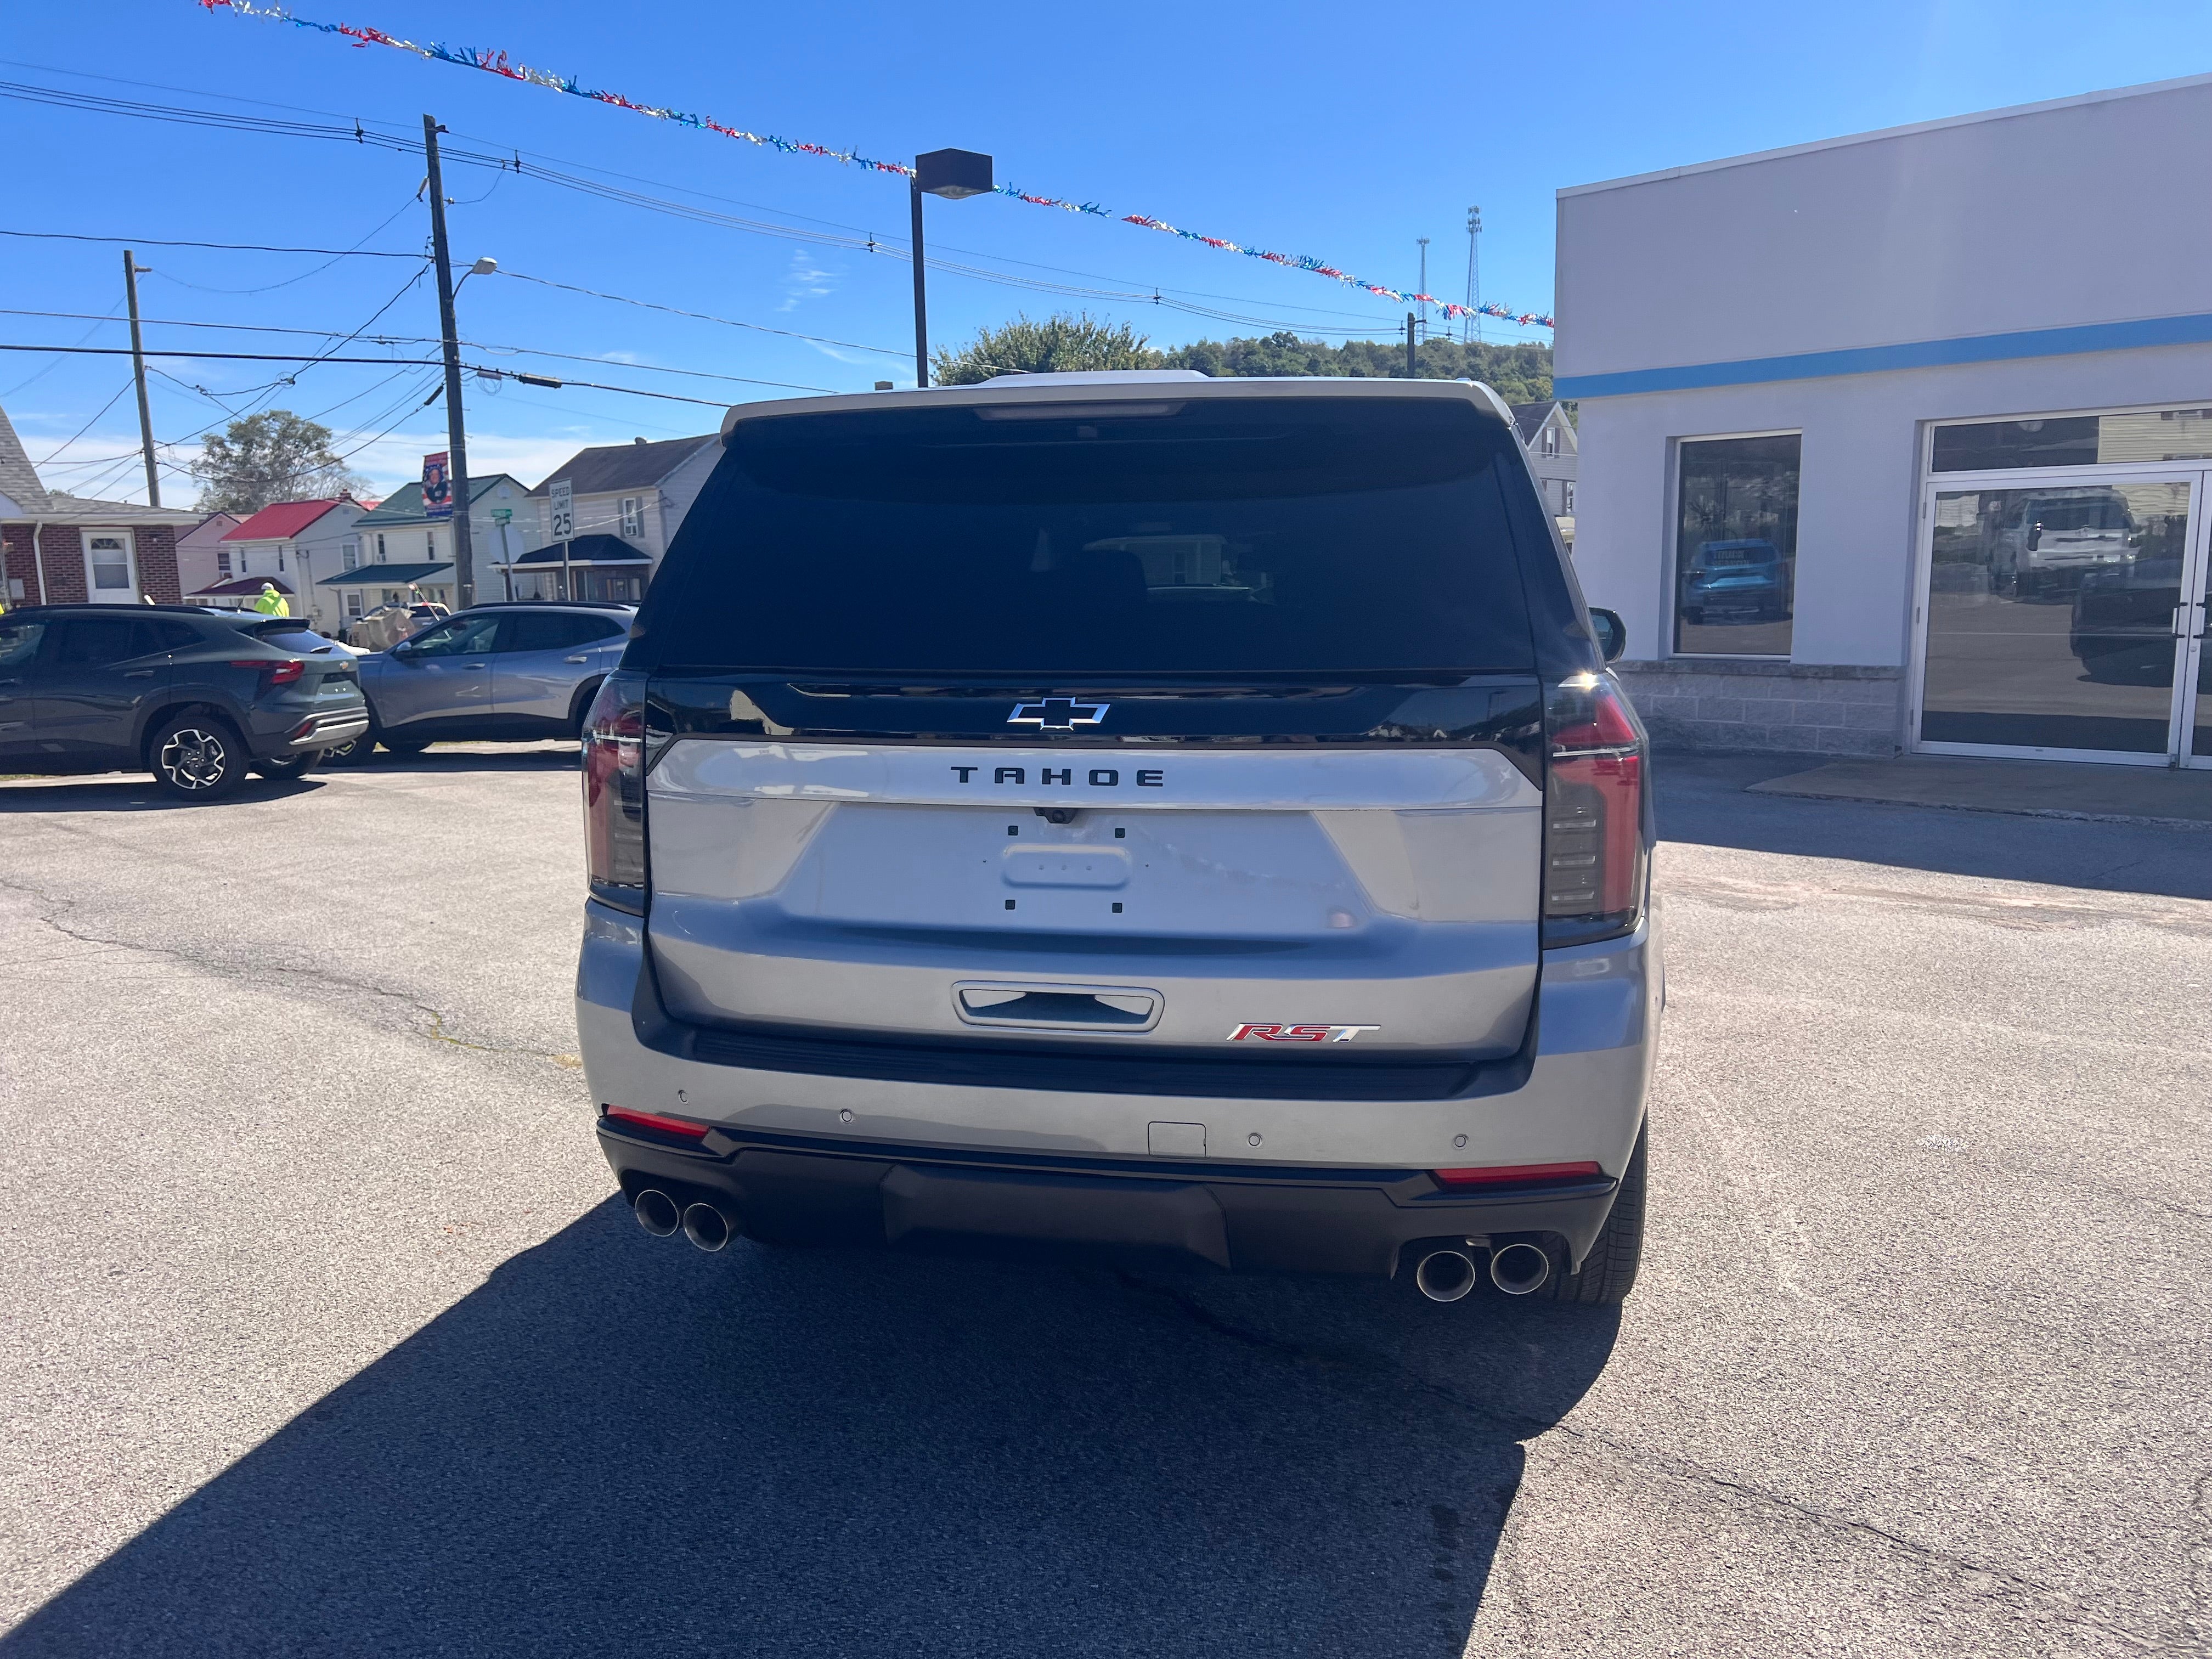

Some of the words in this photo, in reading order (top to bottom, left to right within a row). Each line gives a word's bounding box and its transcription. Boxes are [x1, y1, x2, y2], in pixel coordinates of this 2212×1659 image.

[551, 486, 570, 498] SPEED
[554, 499, 568, 510] LIMIT
[554, 513, 572, 535] 25
[950, 766, 1164, 787] TAHOE
[1226, 1023, 1381, 1042] RST
